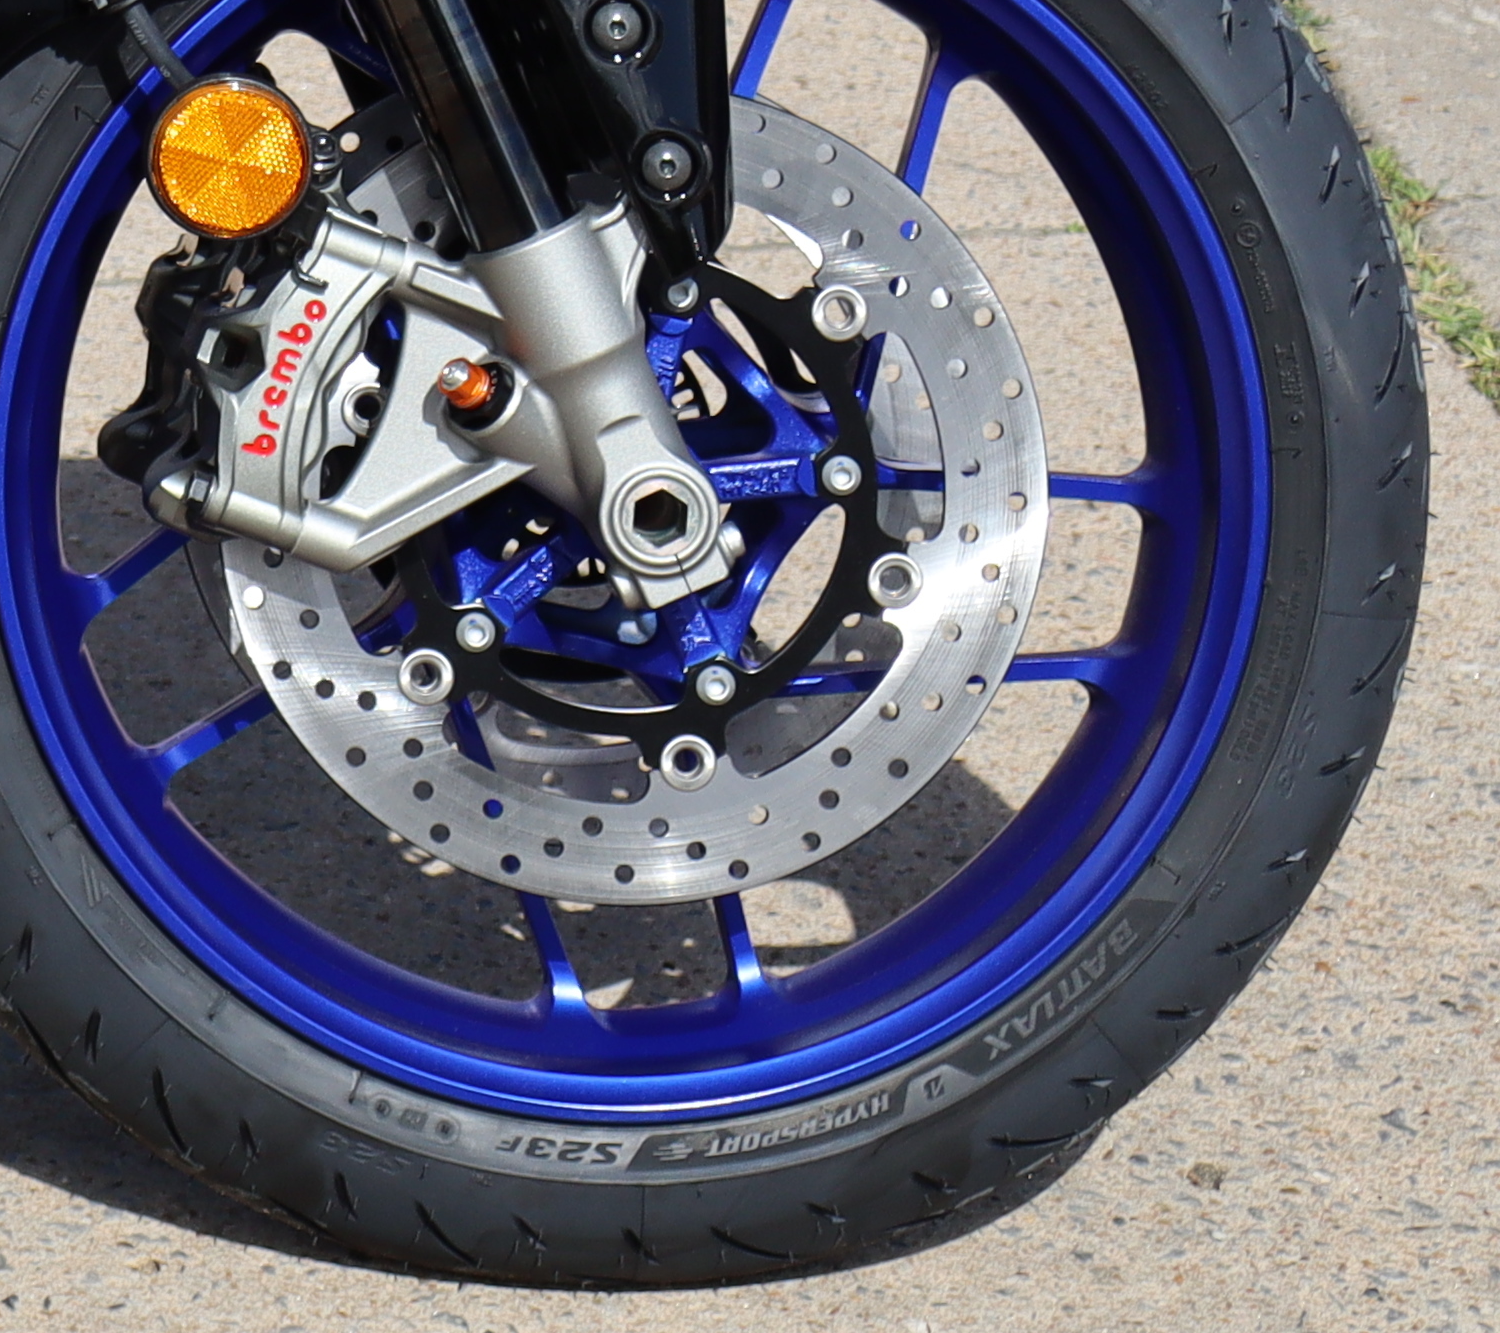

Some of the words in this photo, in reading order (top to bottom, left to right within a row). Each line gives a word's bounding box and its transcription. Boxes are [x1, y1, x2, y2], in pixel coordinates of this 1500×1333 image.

[241, 299, 327, 457] brembo
[986, 916, 1139, 1062] BATTLAX
[497, 1135, 624, 1166] S23F
[707, 1093, 890, 1158] HYPERSPORT
